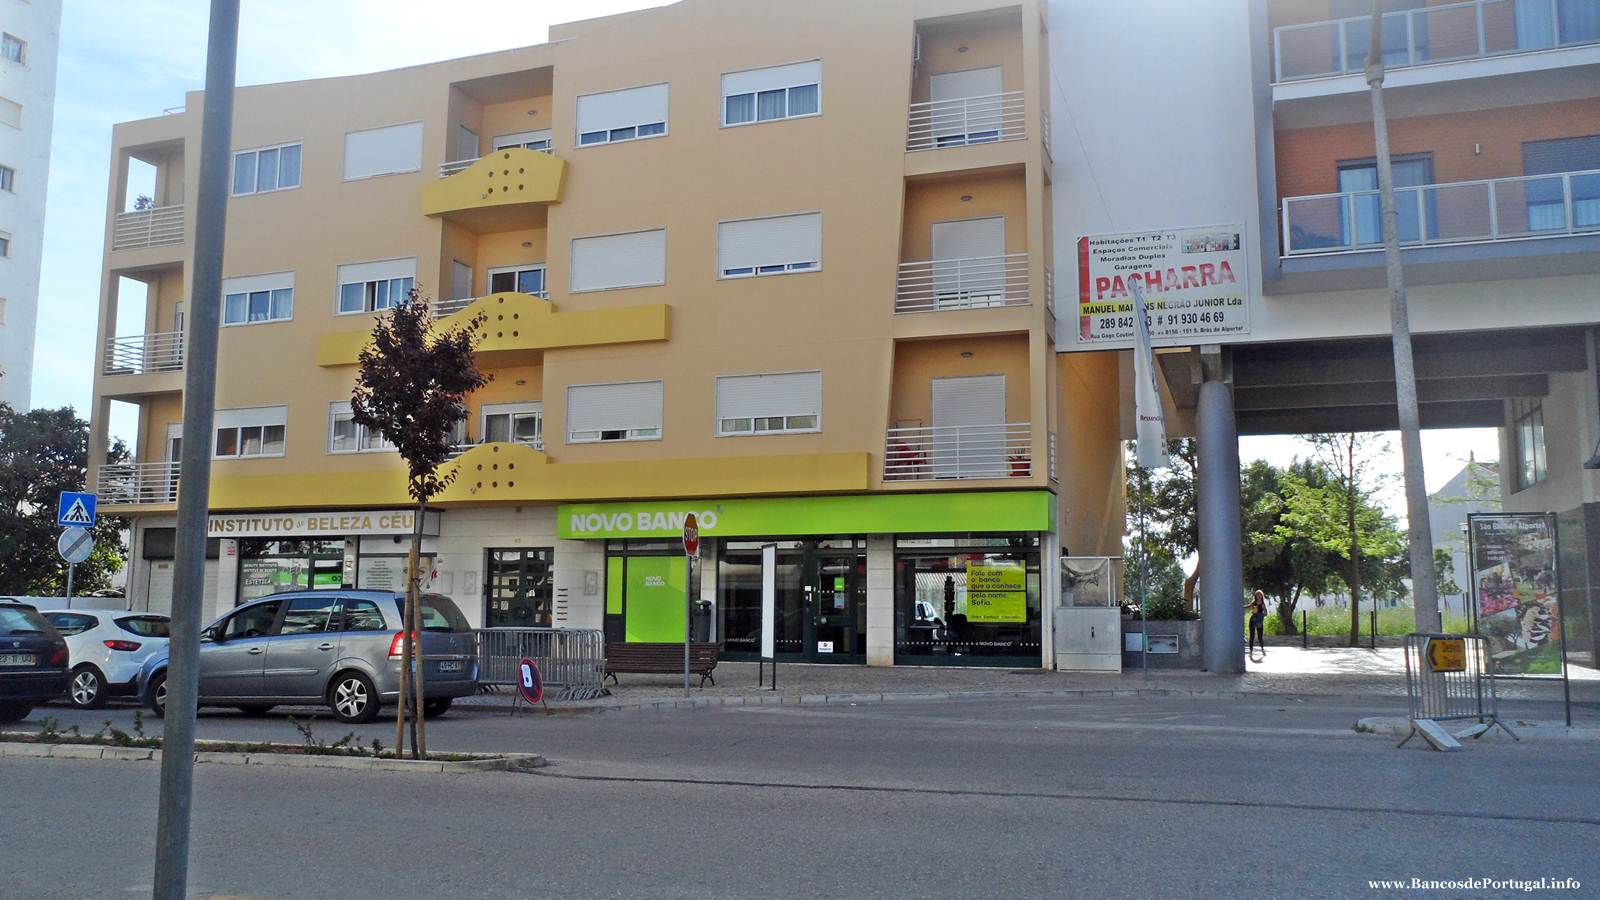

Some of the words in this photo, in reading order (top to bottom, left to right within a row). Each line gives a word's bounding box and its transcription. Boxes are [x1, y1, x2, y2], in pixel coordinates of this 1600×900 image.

[1089, 237, 1134, 246] Habitações
[1092, 246, 1126, 254] Espaços
[1100, 255, 1136, 263] Moradias
[1114, 263, 1153, 271] Garagens
[1095, 260, 1237, 300] PACHARRA
[1083, 303, 1116, 314] MANUEL
[1227, 297, 1242, 306] Lda
[1100, 318, 1116, 329] 289
[1118, 317, 1134, 328] 842
[1167, 314, 1178, 325] 91
[1181, 313, 1198, 324] 930
[1200, 312, 1211, 323] 46
[1213, 311, 1225, 322] 69
[209, 517, 294, 532] INSTITUTO
[307, 515, 372, 531] BELEZA
[379, 511, 414, 529] CÉU
[571, 513, 633, 532] NOVO
[637, 510, 718, 530] BANO
[684, 528, 698, 542] STOP
